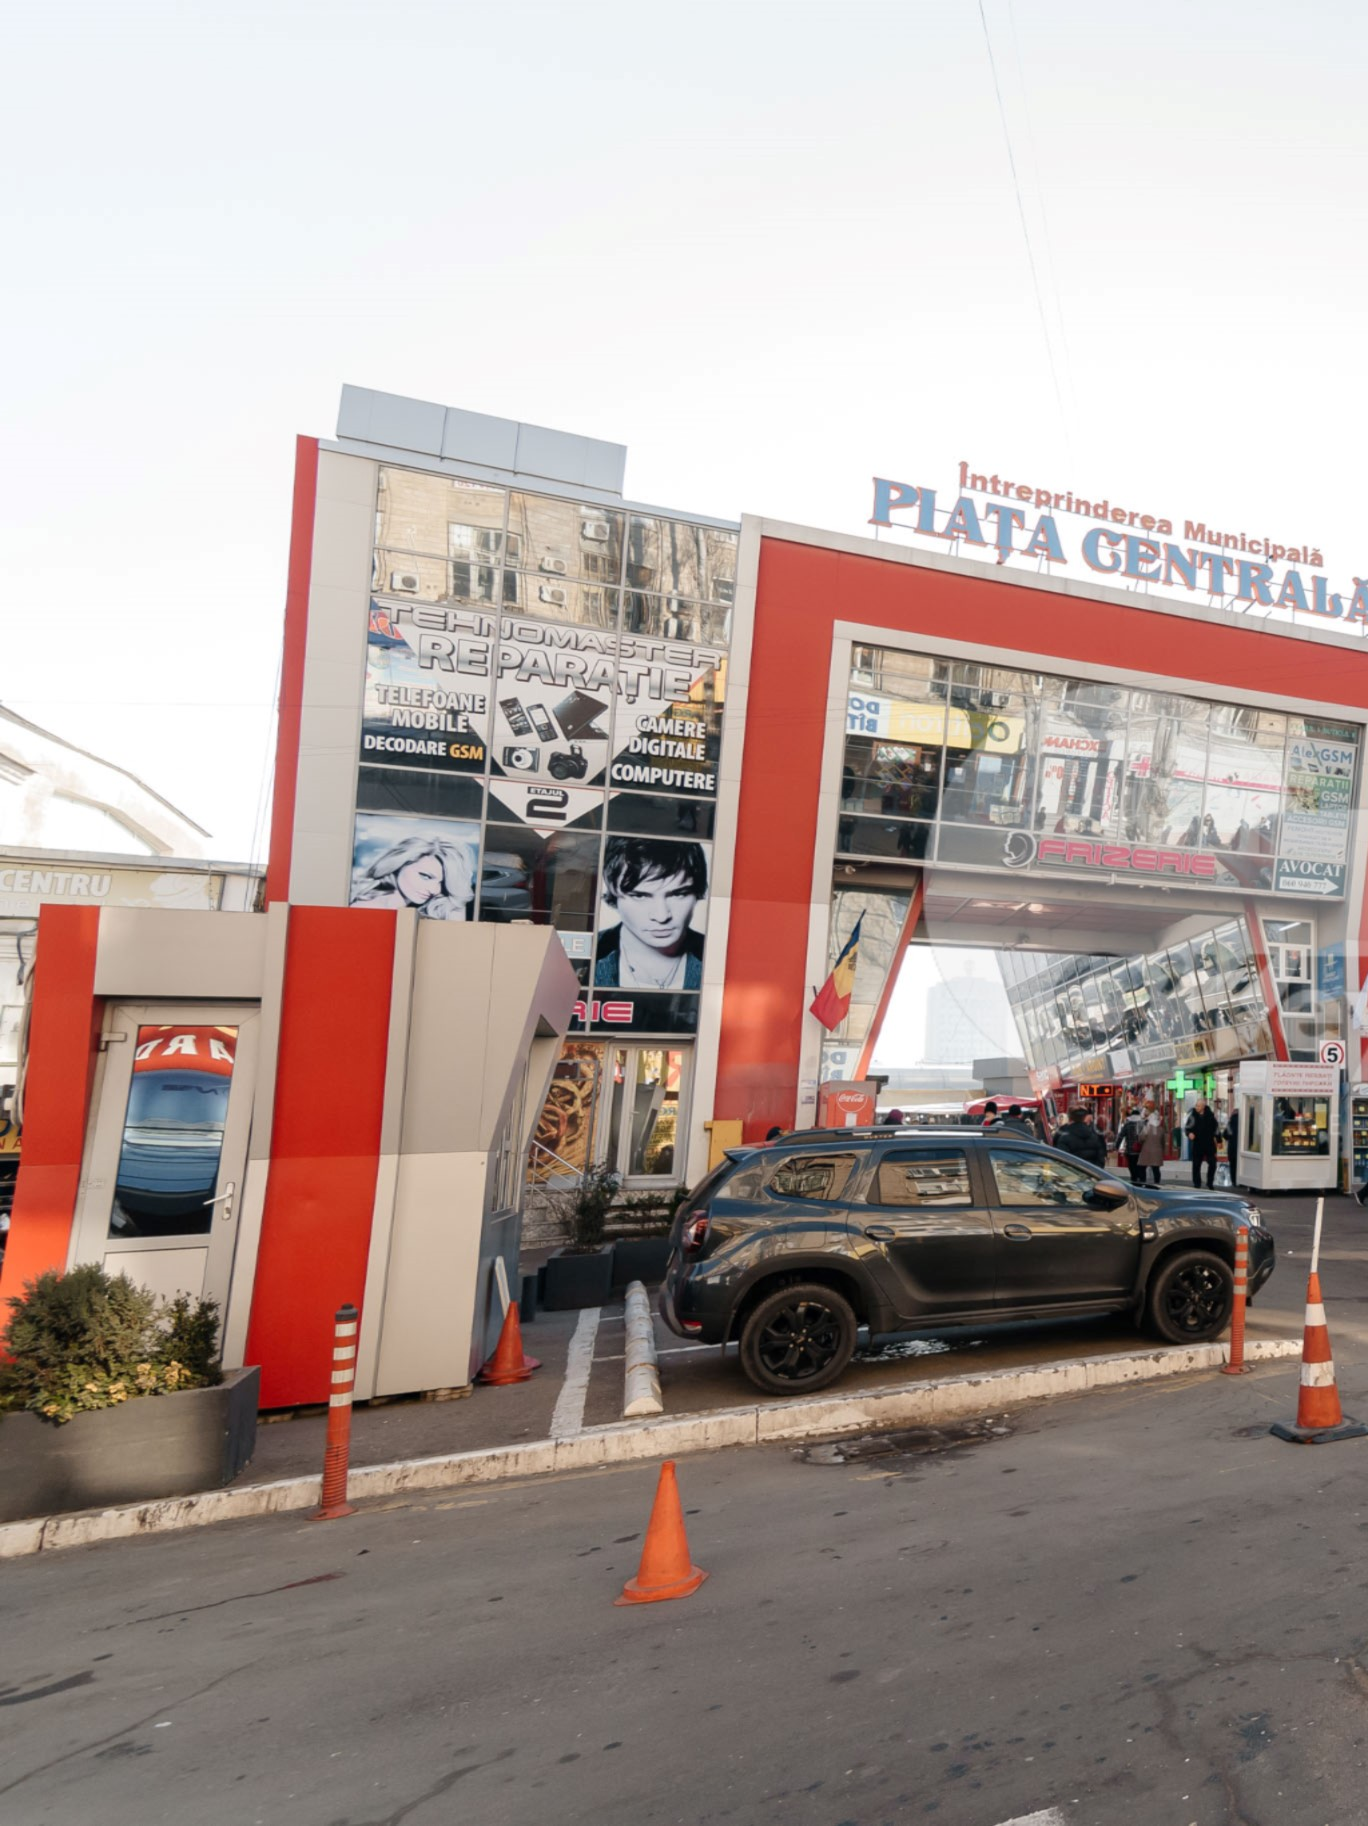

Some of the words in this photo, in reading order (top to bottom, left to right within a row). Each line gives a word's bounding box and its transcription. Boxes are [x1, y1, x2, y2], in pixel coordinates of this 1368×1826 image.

[867, 477, 1067, 565] PIAȚA
[958, 461, 1172, 535] Întreprinderea
[1184, 521, 1324, 567] Municipală
[378, 601, 723, 669] TEHNOMASTER
[418, 633, 694, 705] REPARAȚIE
[375, 684, 486, 714] TELEFOANE
[392, 709, 469, 733] MOBILE
[636, 715, 707, 739] CAMERE
[364, 735, 447, 757] DECODARE
[449, 745, 484, 761] GSM
[629, 737, 706, 762] DIGITALE
[1320, 748, 1353, 764] GSM
[611, 764, 715, 791] COMPUTERE
[528, 786, 566, 799] ETAJUL
[1322, 791, 1350, 803] GSM
[526, 793, 569, 822] 2
[1037, 839, 1217, 876] FRIZERIE
[1279, 860, 1343, 877] AVOCAT
[0, 868, 112, 897] CENTRU
[1327, 1047, 1338, 1063] 5
